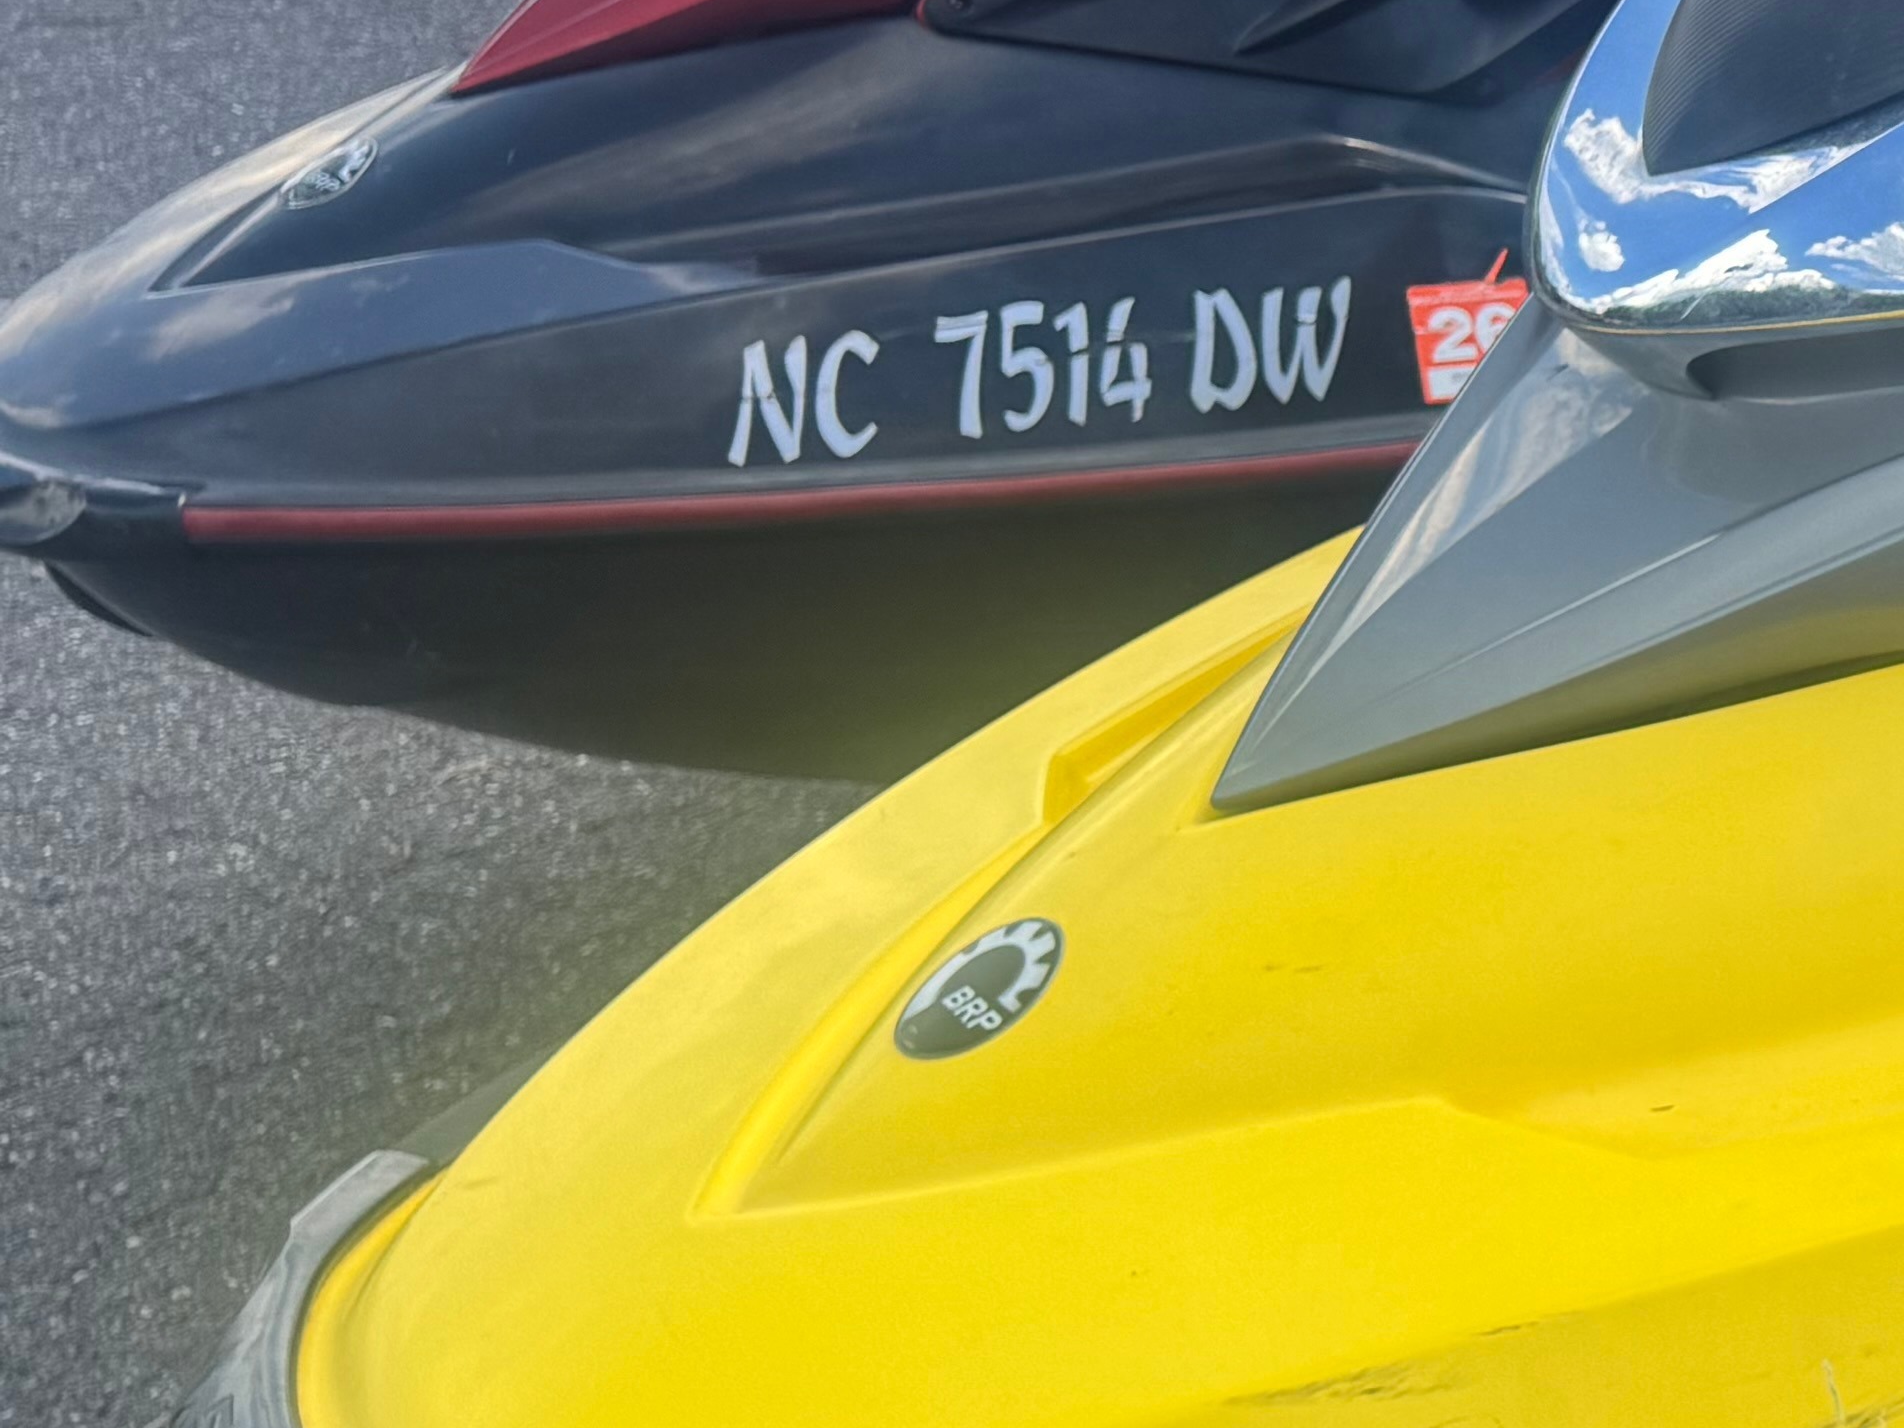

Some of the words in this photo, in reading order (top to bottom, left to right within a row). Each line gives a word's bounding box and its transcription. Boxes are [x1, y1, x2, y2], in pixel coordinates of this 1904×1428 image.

[728, 329, 880, 467] NC
[934, 297, 1153, 440] 7514
[1190, 276, 1352, 413] DW
[941, 984, 1004, 1031] BRP
